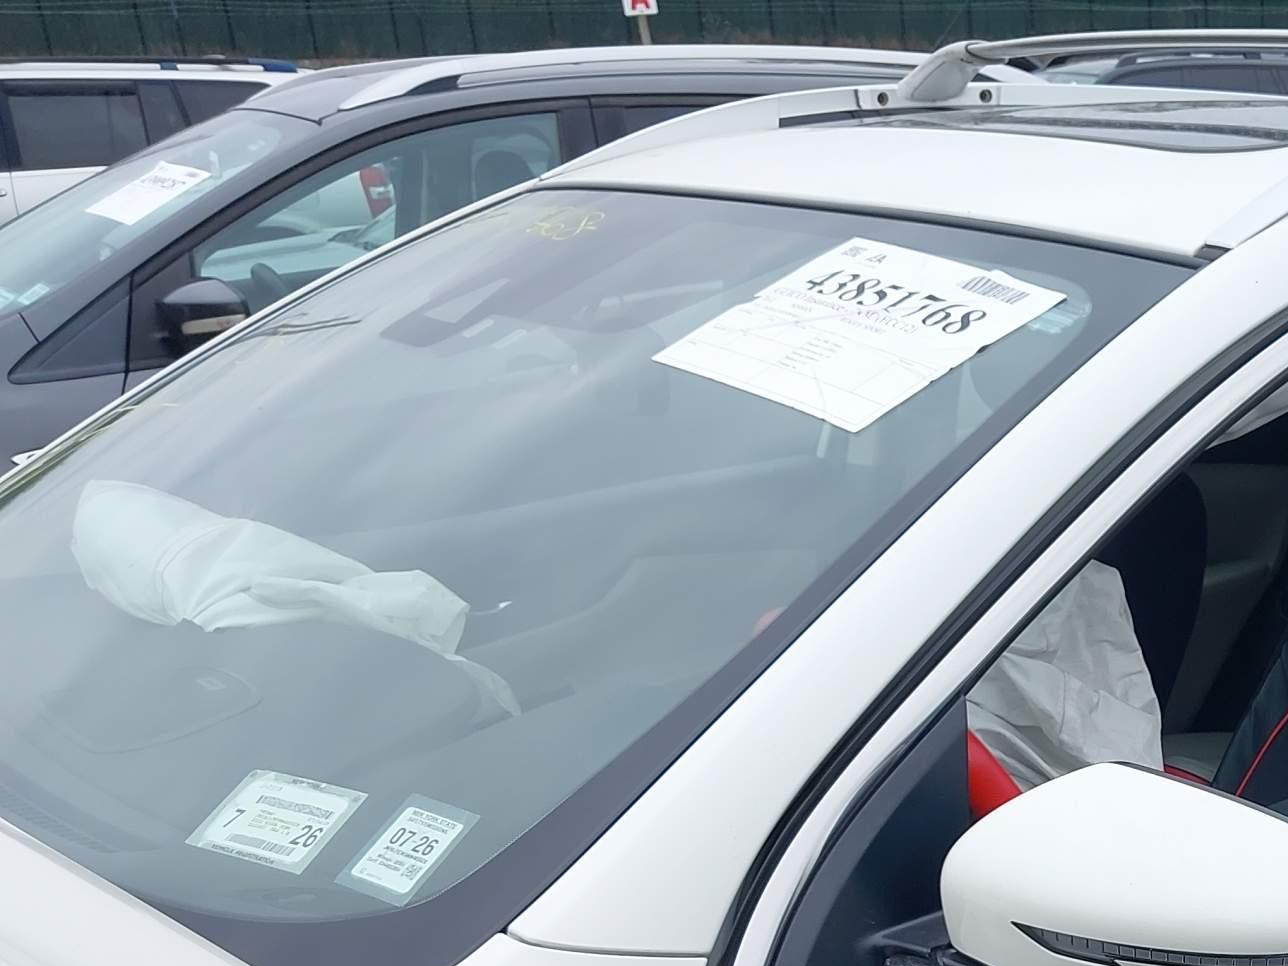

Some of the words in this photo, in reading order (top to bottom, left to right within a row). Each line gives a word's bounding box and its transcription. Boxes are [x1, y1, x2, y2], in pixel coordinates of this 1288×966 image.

[806, 270, 987, 334] 43851768
[223, 808, 247, 829] 7
[289, 824, 324, 848] 26
